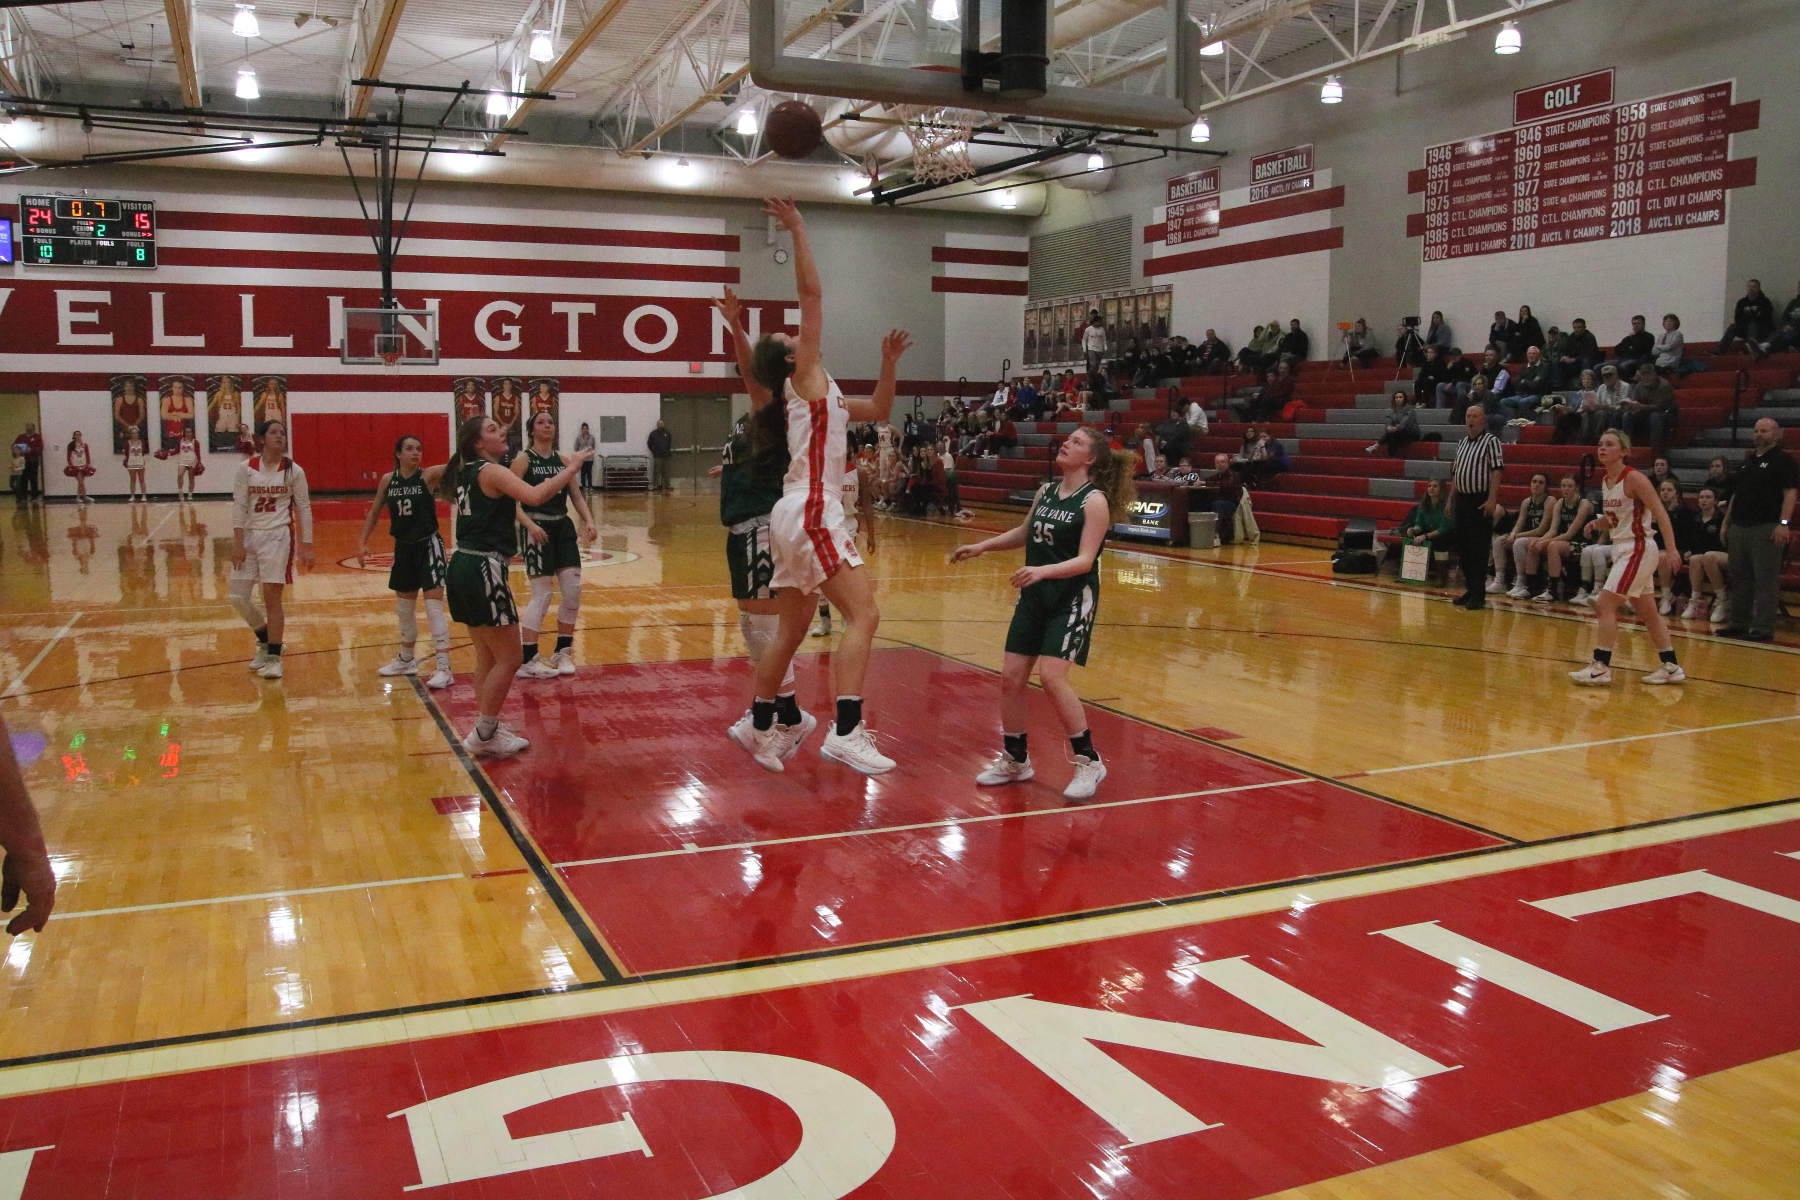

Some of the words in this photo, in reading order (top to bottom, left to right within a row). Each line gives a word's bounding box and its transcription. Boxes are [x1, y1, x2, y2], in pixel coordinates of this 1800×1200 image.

[1544, 84, 1581, 110] GOLF
[1616, 102, 1647, 125] 1958
[1649, 101, 1667, 114] STATE
[1668, 93, 1705, 110] CHAMPIONS
[1515, 126, 1542, 146] 1946
[1545, 123, 1565, 137] STATE
[1567, 113, 1610, 133] CHAMPIONS
[1614, 121, 1646, 144] 1970
[1650, 121, 1668, 133] STATE
[1668, 113, 1705, 129] CHAMPIONS
[1428, 145, 1452, 164] 1946
[1514, 143, 1541, 164] 1960
[1543, 143, 1558, 154] STATE
[1559, 137, 1590, 151] CHAMPIONS
[1613, 140, 1645, 162] 1974
[1649, 140, 1667, 152] STATE
[1667, 133, 1704, 148] CHAMPIONS
[1255, 153, 1308, 180] BASKETBALL
[1427, 161, 1451, 180] 1959
[1453, 162, 1466, 172] STATE
[1466, 156, 1493, 170] CHAMPIONS
[1513, 160, 1540, 180] 1972
[1544, 160, 1559, 171] STATE
[1559, 155, 1590, 168] CHAMPIONS
[1613, 159, 1645, 181] 1978
[1648, 159, 1666, 171] STATE
[1666, 153, 1703, 168] CHAMPIONS
[1170, 176, 1215, 200] BASKETBALL
[1251, 185, 1269, 201] 2016
[1427, 179, 1449, 197] 1971
[1464, 174, 1492, 186] CHAMPIONS
[1513, 178, 1540, 198] 1977
[1543, 179, 1558, 189] STATE
[1559, 173, 1590, 186] CHAMPIONS
[1612, 179, 1643, 200] 1984
[1647, 178, 1668, 191] C.T.L.
[1670, 168, 1723, 188] CHAMPIONS
[26, 197, 51, 207] HOME
[71, 201, 105, 218] 0.7
[122, 202, 153, 212] VISITOR
[1167, 204, 1185, 219] 1945
[1426, 195, 1449, 213] 1975
[1465, 190, 1493, 203] CHAMPIONS
[1511, 196, 1539, 215] 1983
[1542, 196, 1559, 207] STATE
[1568, 188, 1607, 203] CHAMPIONS
[1611, 198, 1640, 219] 2001
[1646, 198, 1662, 211] CTL
[1664, 195, 1677, 208] DIV
[1679, 194, 1685, 206] II
[1687, 188, 1723, 205] CHAMPS
[29, 208, 52, 225] 24
[134, 213, 151, 229] 15
[1167, 217, 1182, 232] 1947
[1425, 211, 1449, 229] 1983
[1468, 204, 1508, 219] CHAMPIONS
[1511, 213, 1538, 233] 1986
[1541, 213, 1560, 225] C.T.L.
[1561, 205, 1606, 222] CHAMPIONS
[1609, 217, 1642, 238] 2018
[1647, 215, 1673, 230] AVCTL
[1675, 214, 1684, 226] IV
[1686, 209, 1720, 225] CHAMPS
[36, 227, 57, 235] BONUS
[72, 225, 95, 233] PERIOD
[97, 224, 106, 237] 2
[1167, 231, 1182, 245] 1968
[1425, 227, 1448, 245] 1985
[1468, 221, 1507, 236] CHAMPIONS
[1509, 232, 1535, 250] 2010
[1541, 231, 1562, 243] AVCTL
[1573, 225, 1605, 239] CHAMPS
[33, 237, 53, 245] FOULS
[39, 245, 53, 258] 10
[1424, 243, 1448, 261] 2002
[1451, 244, 1462, 256] CTL
[1463, 242, 1474, 254] DIV
[1480, 238, 1507, 252] CHAMPS
[136, 248, 146, 261] 8
[0, 286, 763, 356] ELLINGTON
[247, 485, 289, 495] CRUSADERS
[387, 484, 423, 498] MULVANE
[254, 496, 278, 514] 22
[396, 498, 413, 517] 12
[1032, 520, 1056, 547] 35
[1142, 518, 1160, 527] BANK
